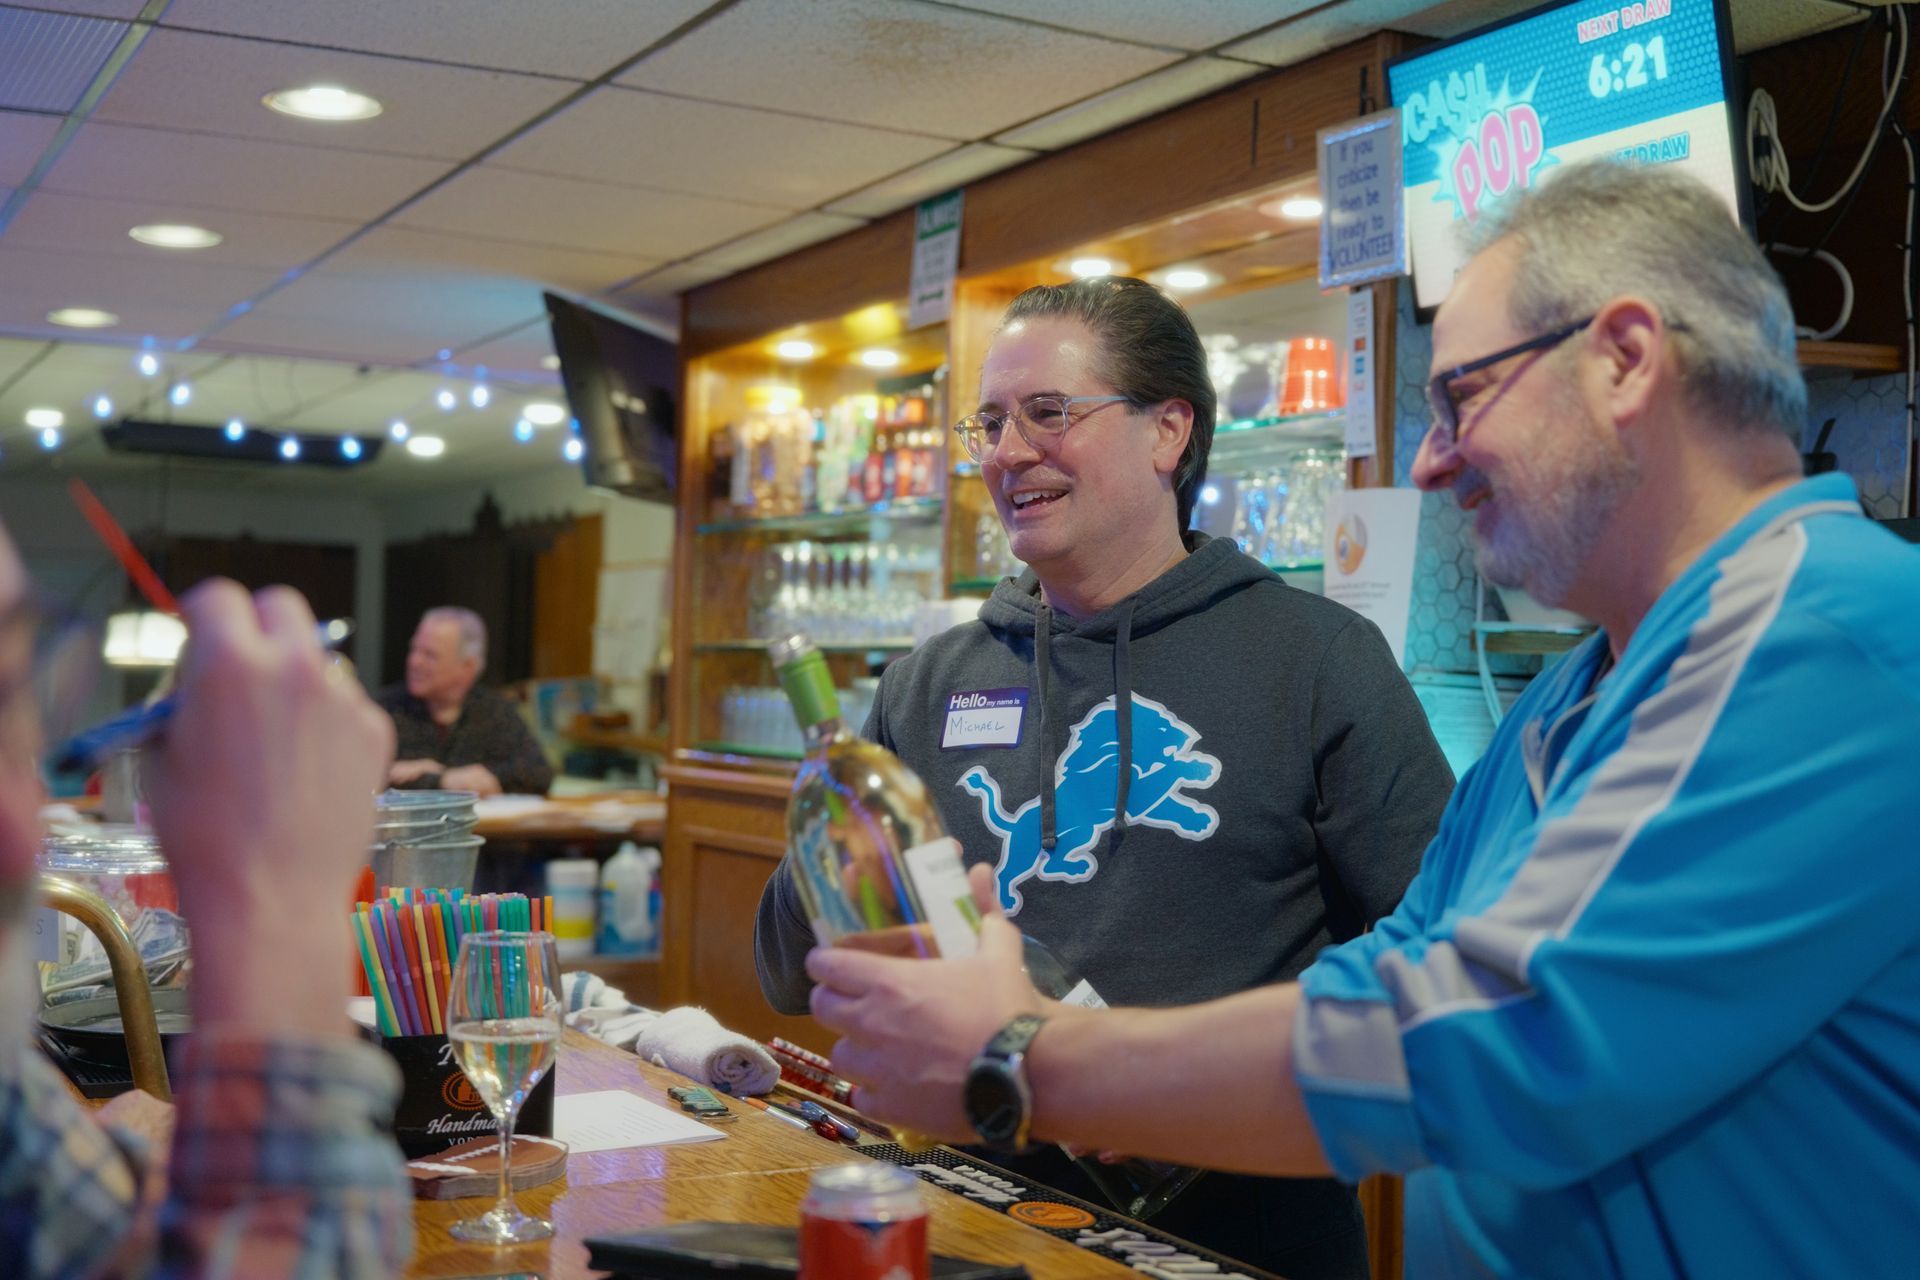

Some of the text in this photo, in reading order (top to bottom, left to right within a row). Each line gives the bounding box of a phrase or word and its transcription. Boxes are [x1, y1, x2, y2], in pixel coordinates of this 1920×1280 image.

[1577, 0, 1671, 44] NEXT DRAW
[1588, 35, 1668, 98] 6:21
[1353, 139, 1374, 163] you
[1635, 131, 1690, 168] DRAW
[1337, 162, 1379, 189] criticize
[1453, 102, 1544, 226] POP
[1364, 186, 1380, 206] be
[1337, 214, 1385, 242] ready to
[949, 693, 987, 710] Hello
[986, 700, 996, 708] my
